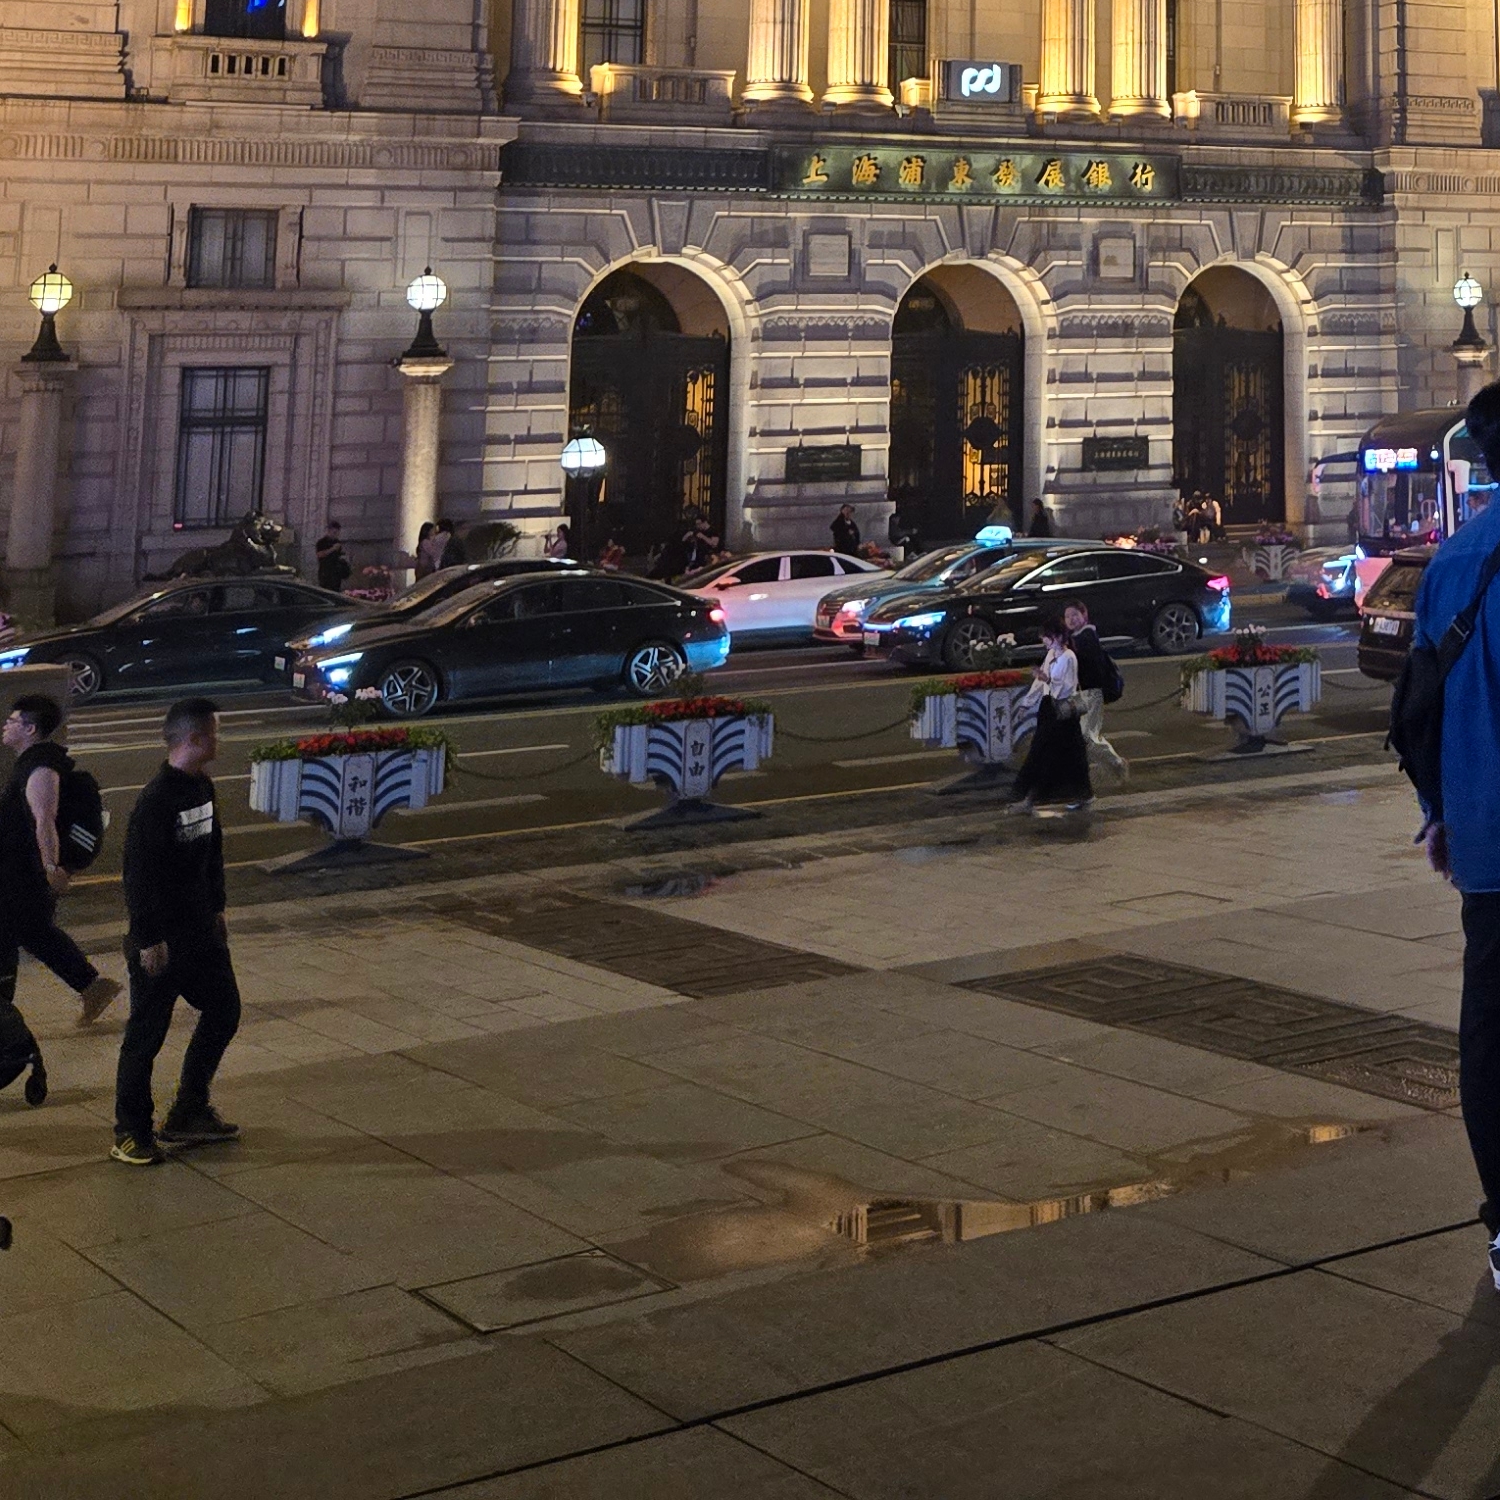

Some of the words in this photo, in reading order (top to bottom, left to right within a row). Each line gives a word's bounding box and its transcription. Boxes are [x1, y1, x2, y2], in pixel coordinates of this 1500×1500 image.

[802, 155, 1156, 193] 上海浦東發展銀行
[1257, 684, 1271, 717] 公正
[993, 706, 1007, 743] 平等
[689, 740, 706, 777] 自由
[346, 776, 368, 816] 和谐
